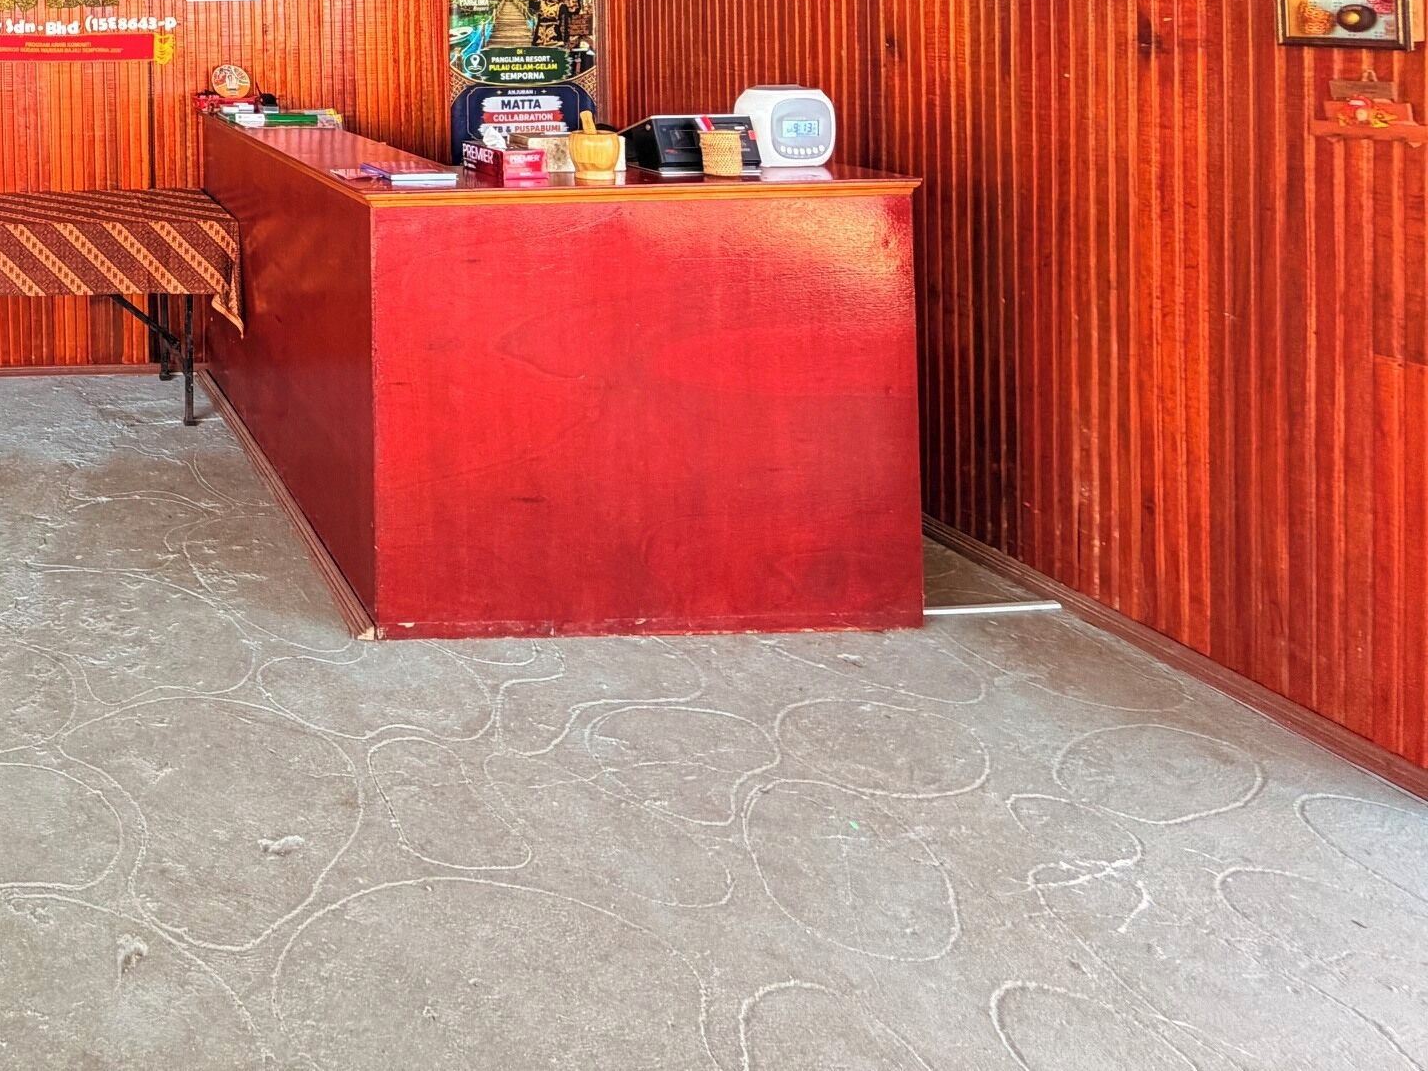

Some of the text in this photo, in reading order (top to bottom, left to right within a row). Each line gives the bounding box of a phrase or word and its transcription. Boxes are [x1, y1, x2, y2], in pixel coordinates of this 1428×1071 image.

[45, 20, 80, 35] Bhd
[500, 72, 545, 80] SEMPORNA
[501, 99, 541, 110] MATTA
[493, 113, 553, 121] COLLABRATION
[462, 143, 493, 164] PREMIER
